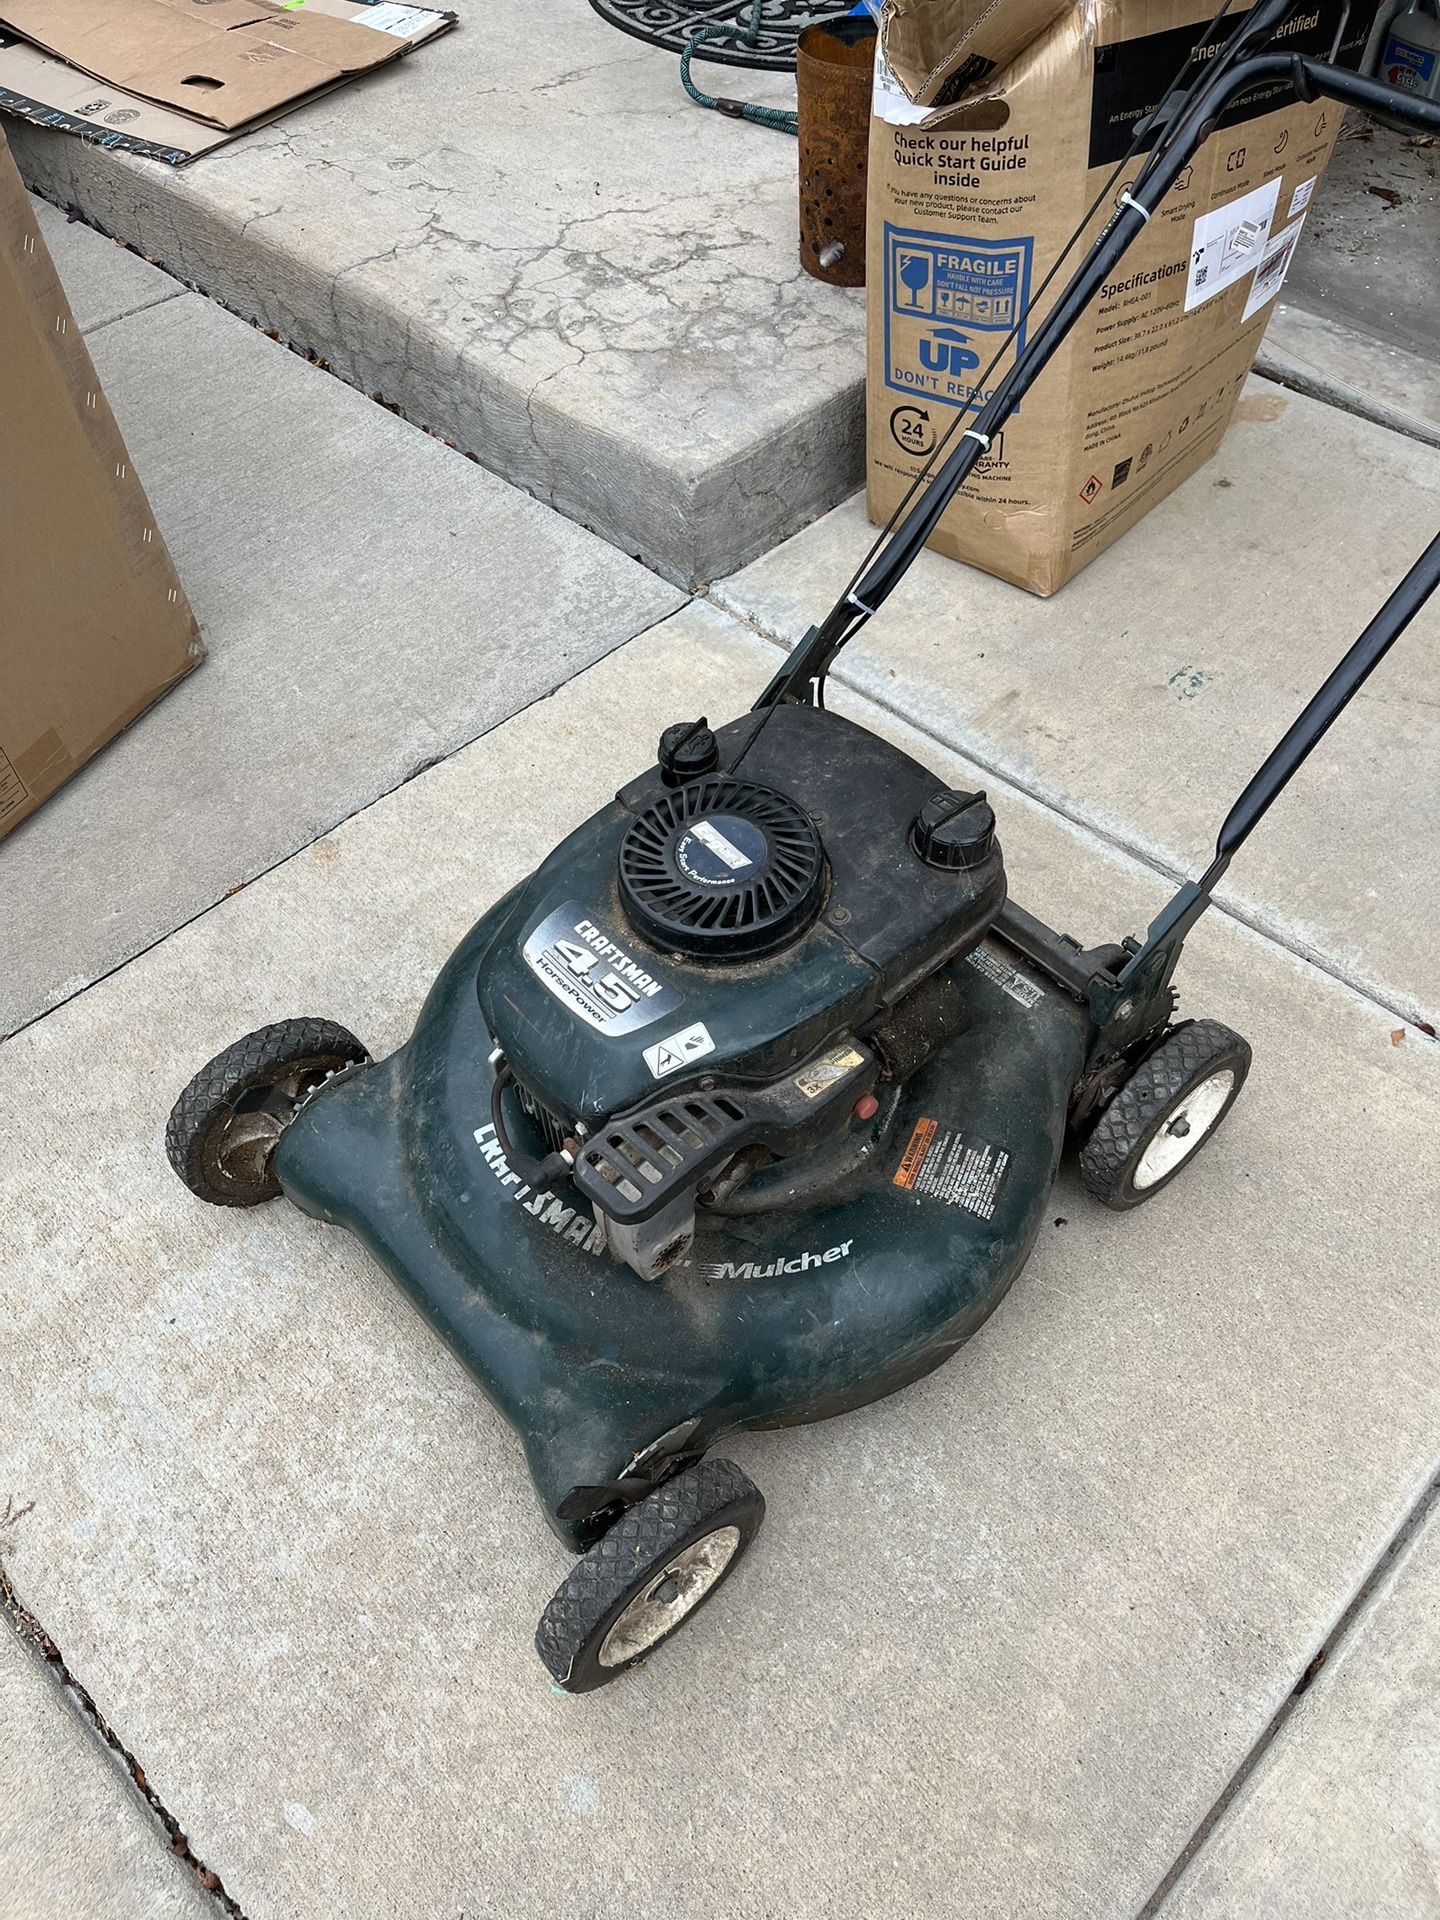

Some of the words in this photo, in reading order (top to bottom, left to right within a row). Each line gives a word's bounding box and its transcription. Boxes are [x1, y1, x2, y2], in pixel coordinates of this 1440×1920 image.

[1270, 10, 1320, 41] ertified
[1119, 105, 1144, 121] Energy
[894, 131, 935, 150] Check
[939, 139, 967, 151] our
[971, 134, 1030, 155] helpful
[894, 149, 934, 168] Quick
[937, 154, 976, 170] Start
[979, 155, 1027, 172] Guide
[934, 171, 981, 188] inside
[1210, 185, 1237, 201] Continuous
[1237, 179, 1251, 192] Mode
[893, 197, 908, 206] your
[909, 199, 925, 207] new
[925, 200, 955, 212] product,
[956, 204, 981, 214] please
[981, 206, 1009, 215] contact
[1010, 205, 1024, 214] our
[901, 189, 918, 199] have
[919, 192, 933, 200] any
[934, 193, 969, 204] questions
[970, 196, 978, 204] or
[979, 197, 1012, 206] concerns
[1013, 194, 1037, 204] about
[913, 207, 947, 219] Customer
[948, 211, 977, 223] Support
[977, 214, 1000, 225] Team.
[1161, 206, 1179, 219] Smart
[1179, 200, 1197, 214] Drying
[1170, 213, 1186, 224] Mode
[937, 253, 1017, 276] FRAGILE
[936, 279, 954, 290] DON'T
[955, 283, 969, 292] FALL
[969, 286, 982, 295] NOT
[982, 287, 1015, 295] PRESSURE
[946, 272, 971, 282] HANDLE
[971, 276, 988, 286] WITH
[987, 277, 1004, 286] CARE
[1100, 260, 1188, 300] Specifications
[1097, 301, 1121, 317] Model:
[1095, 323, 1117, 336] Power
[1116, 315, 1140, 331] Supply:
[1140, 310, 1150, 320] AC
[1093, 339, 1119, 355] Product
[1118, 334, 1134, 347] Size:
[919, 338, 980, 377] UP
[1091, 359, 1116, 374] Weight:
[894, 367, 939, 390] DON'T
[947, 381, 995, 402] REPAC
[901, 418, 925, 439] 24
[901, 435, 925, 448] HOURS
[873, 458, 883, 467] We
[884, 462, 895, 472] will
[976, 493, 997, 504] within
[1007, 498, 1031, 506] hours.
[981, 474, 1013, 482] MACHINE
[678, 836, 693, 852] Easy
[679, 852, 690, 872] Start
[687, 869, 736, 885] Performance
[573, 919, 663, 997] CRAFTSMAN
[553, 937, 641, 1014] 4.5
[535, 957, 608, 1023] HorsePower
[903, 1131, 925, 1165] WARNING
[714, 1238, 854, 1280] Mulcher
